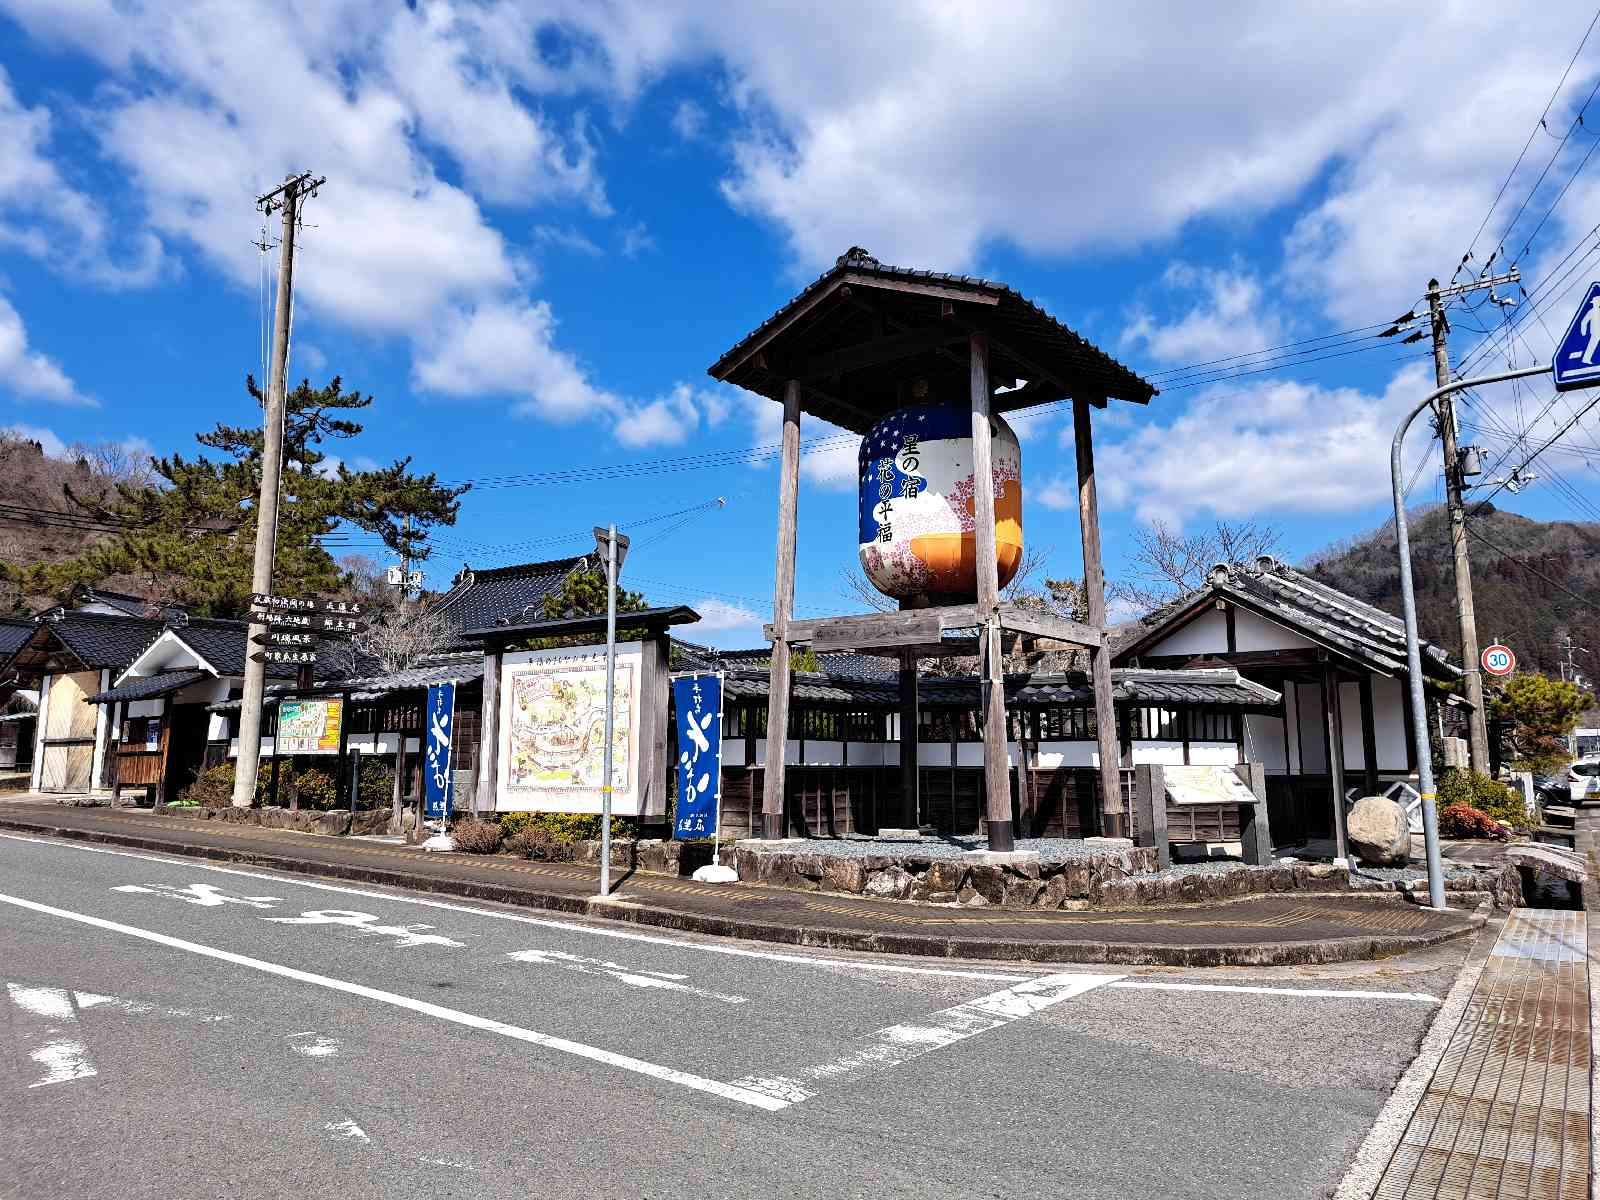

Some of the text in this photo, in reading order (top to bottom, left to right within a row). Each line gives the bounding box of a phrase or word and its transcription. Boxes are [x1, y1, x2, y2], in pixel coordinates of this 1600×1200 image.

[901, 434, 920, 499] 星の宿
[879, 458, 895, 542] 花の平福
[1489, 653, 1507, 667] 30
